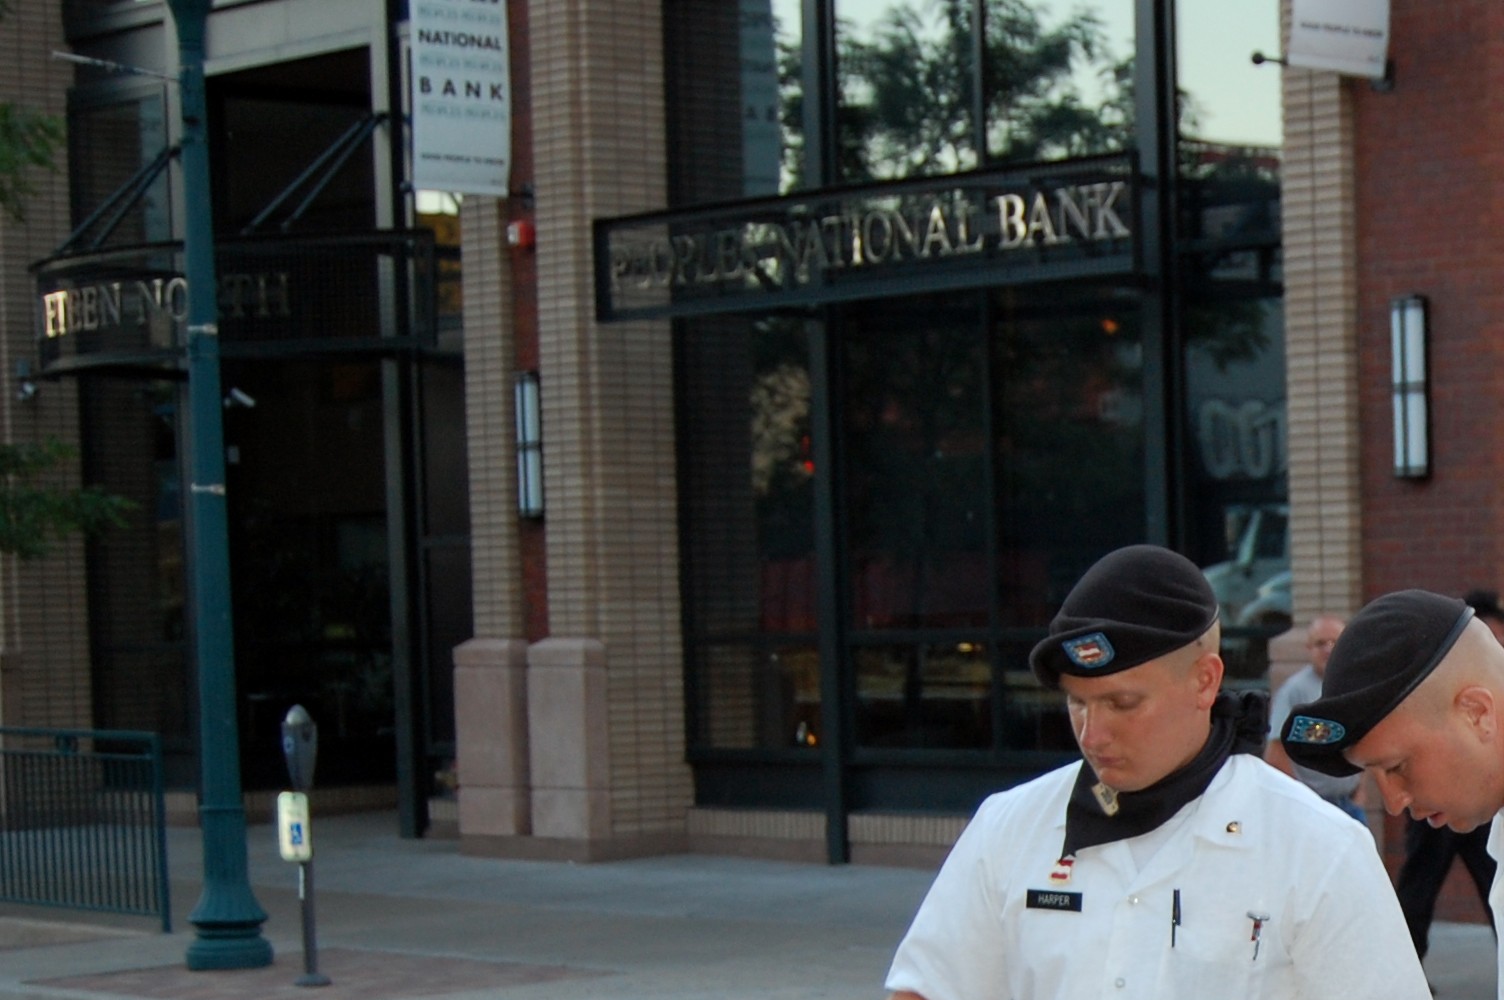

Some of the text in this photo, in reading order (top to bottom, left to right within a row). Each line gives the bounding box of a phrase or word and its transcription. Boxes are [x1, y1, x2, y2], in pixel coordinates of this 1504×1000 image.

[418, 28, 503, 51] NATIONAL
[419, 76, 503, 101] BANK
[776, 187, 985, 285] NATIONAL
[995, 181, 1131, 249] BANK
[136, 274, 293, 326] NOTH
[1037, 893, 1071, 907] HARPER
